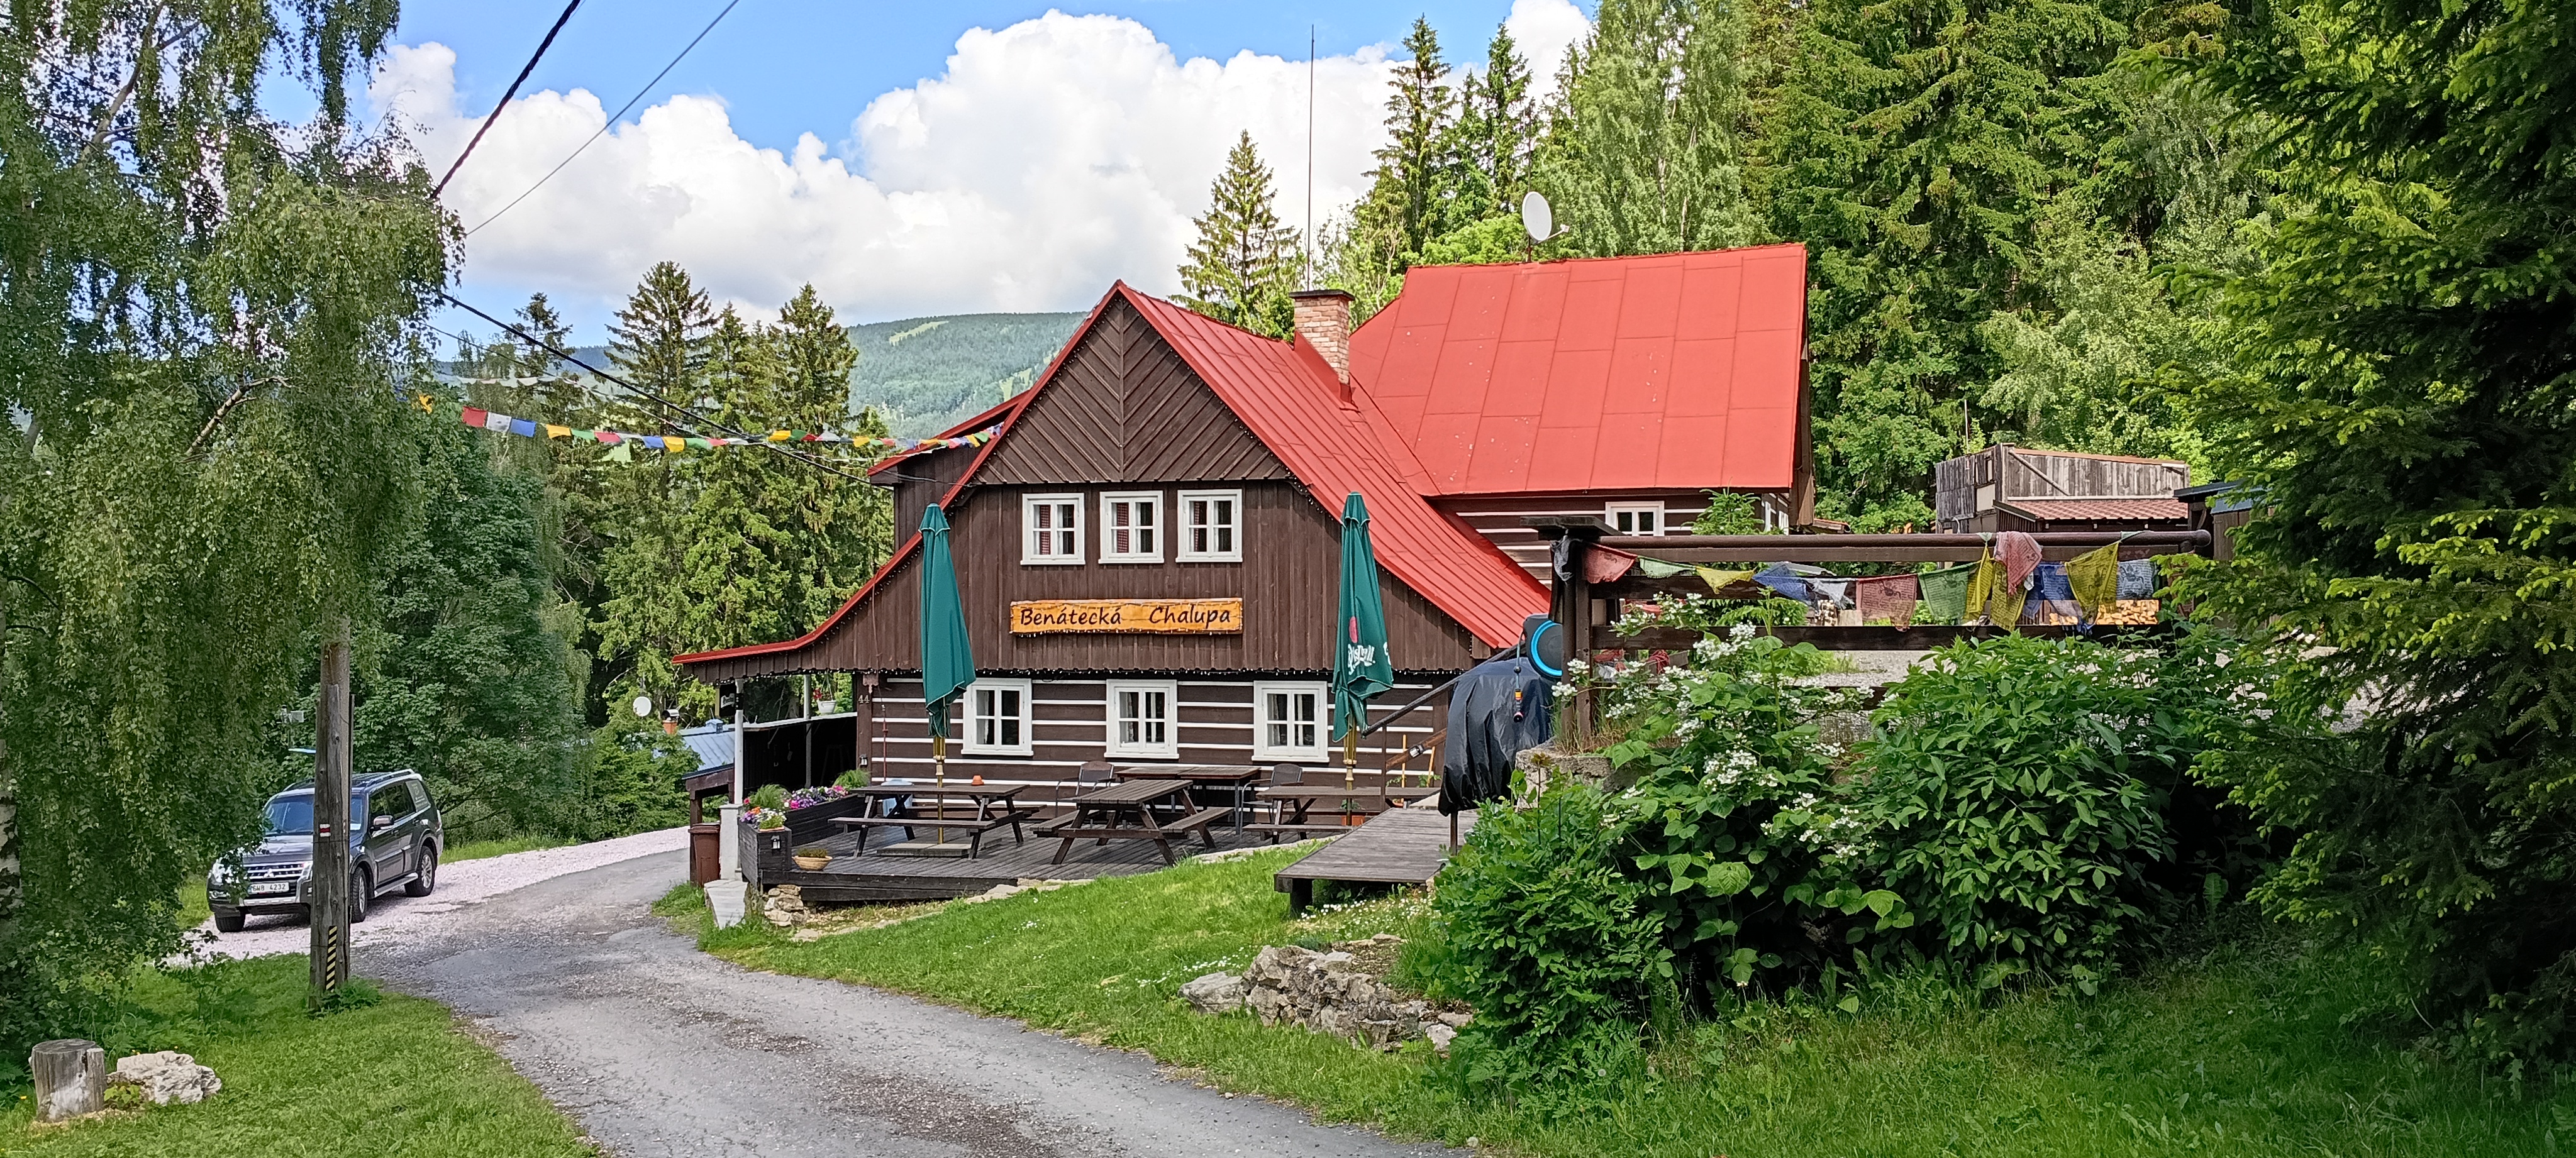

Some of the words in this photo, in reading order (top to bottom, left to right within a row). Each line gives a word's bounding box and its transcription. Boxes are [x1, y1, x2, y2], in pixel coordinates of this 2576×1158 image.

[1021, 607, 1121, 626] Benátecká
[1149, 605, 1230, 629] Chalupa
[858, 695, 870, 703] 44
